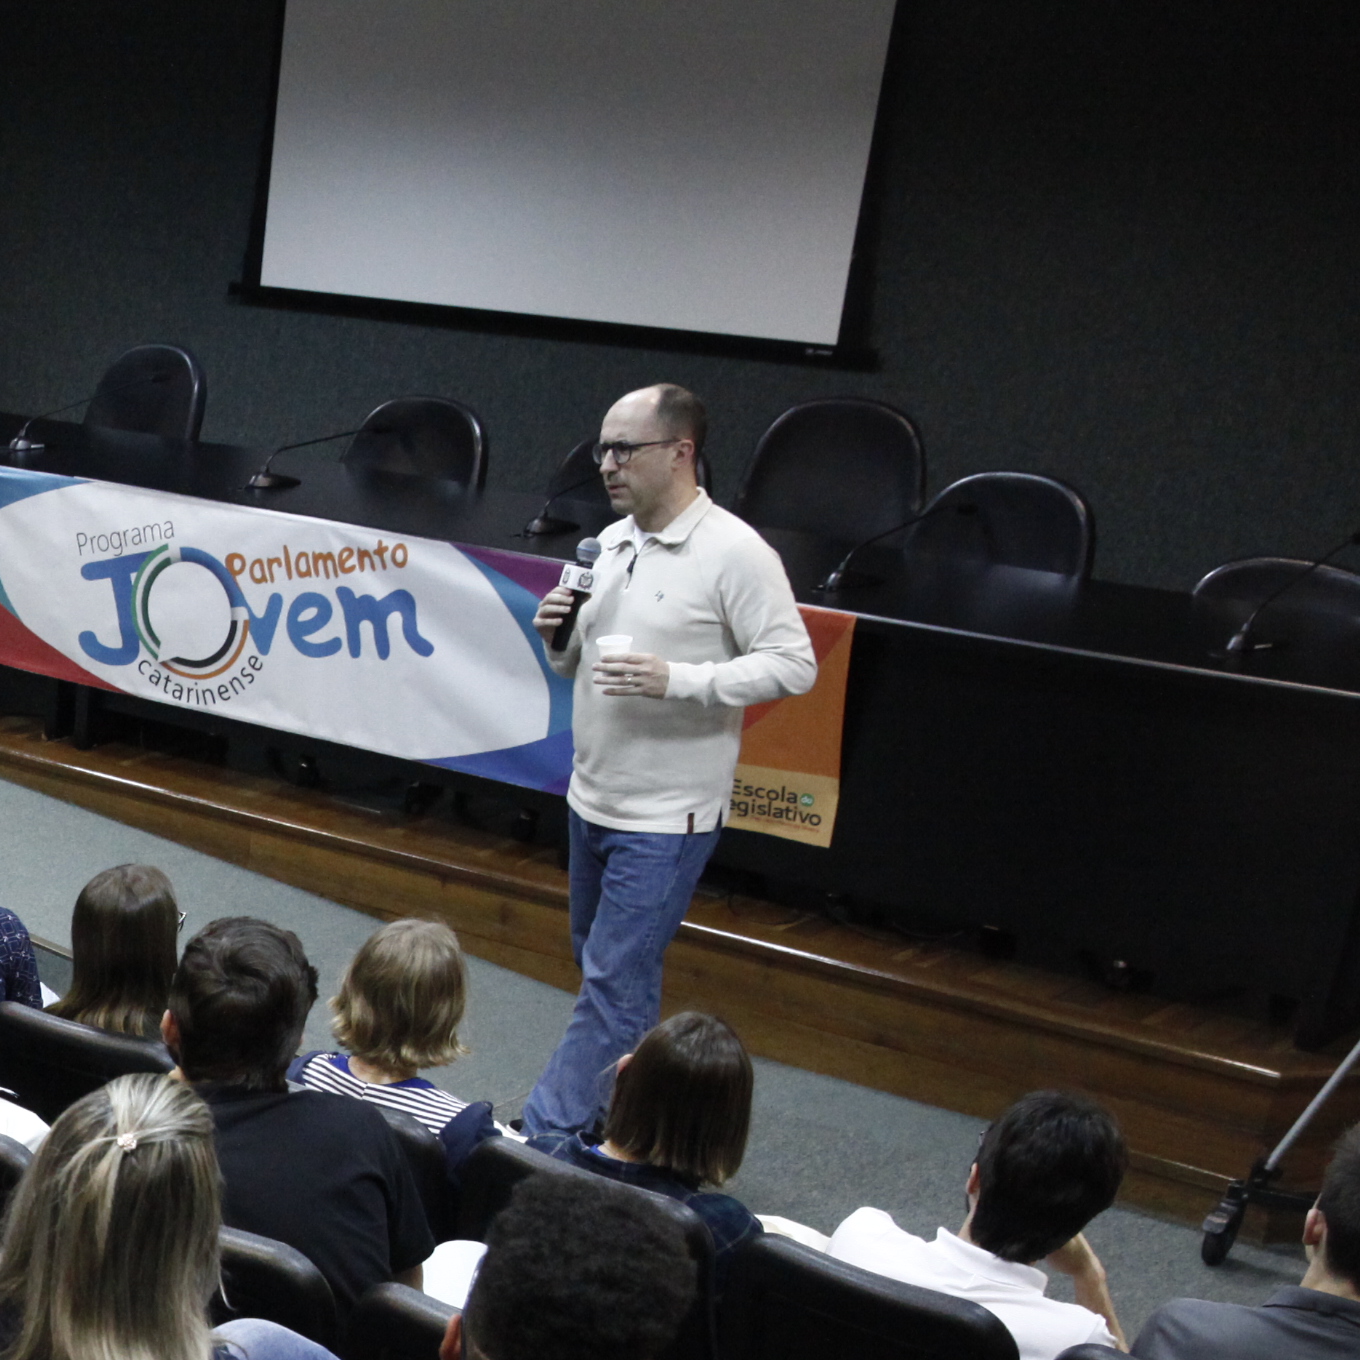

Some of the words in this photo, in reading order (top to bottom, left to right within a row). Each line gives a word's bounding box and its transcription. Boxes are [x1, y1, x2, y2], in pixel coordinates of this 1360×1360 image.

[76, 520, 175, 556] Programa
[225, 539, 408, 592] Parlamento
[732, 779, 798, 804] Escola
[729, 798, 822, 826] egislativo
